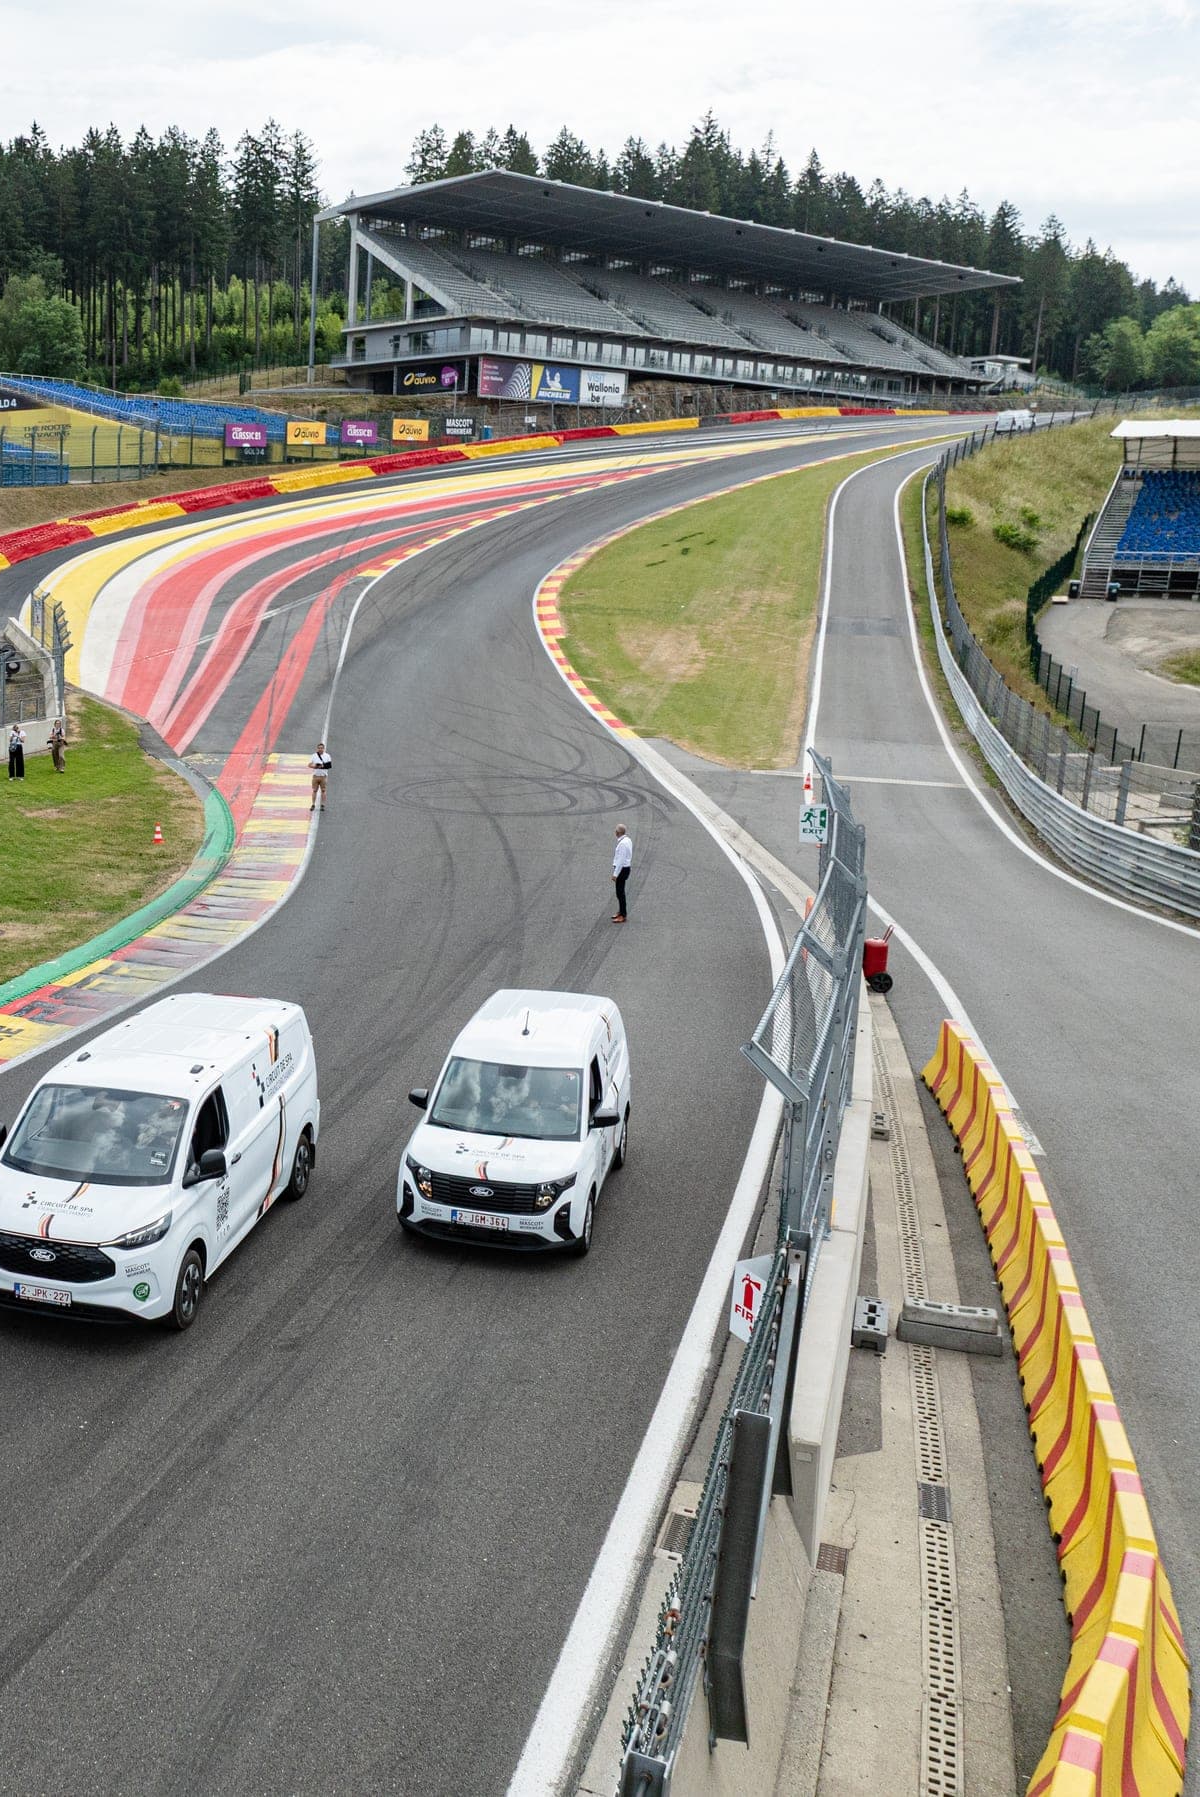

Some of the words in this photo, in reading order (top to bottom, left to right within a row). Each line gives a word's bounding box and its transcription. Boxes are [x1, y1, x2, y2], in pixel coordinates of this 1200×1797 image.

[587, 382, 620, 394] Wallonia
[538, 390, 571, 400] MICHELIN
[10, 398, 17, 407] 4
[446, 419, 470, 427] MASCOT
[446, 427, 473, 435] WORKWEAR
[40, 1200, 68, 1209] CIRCUIT
[33, 1250, 53, 1261] Ford
[125, 1263, 147, 1274] MASCOT
[734, 1303, 754, 1324] FIR
